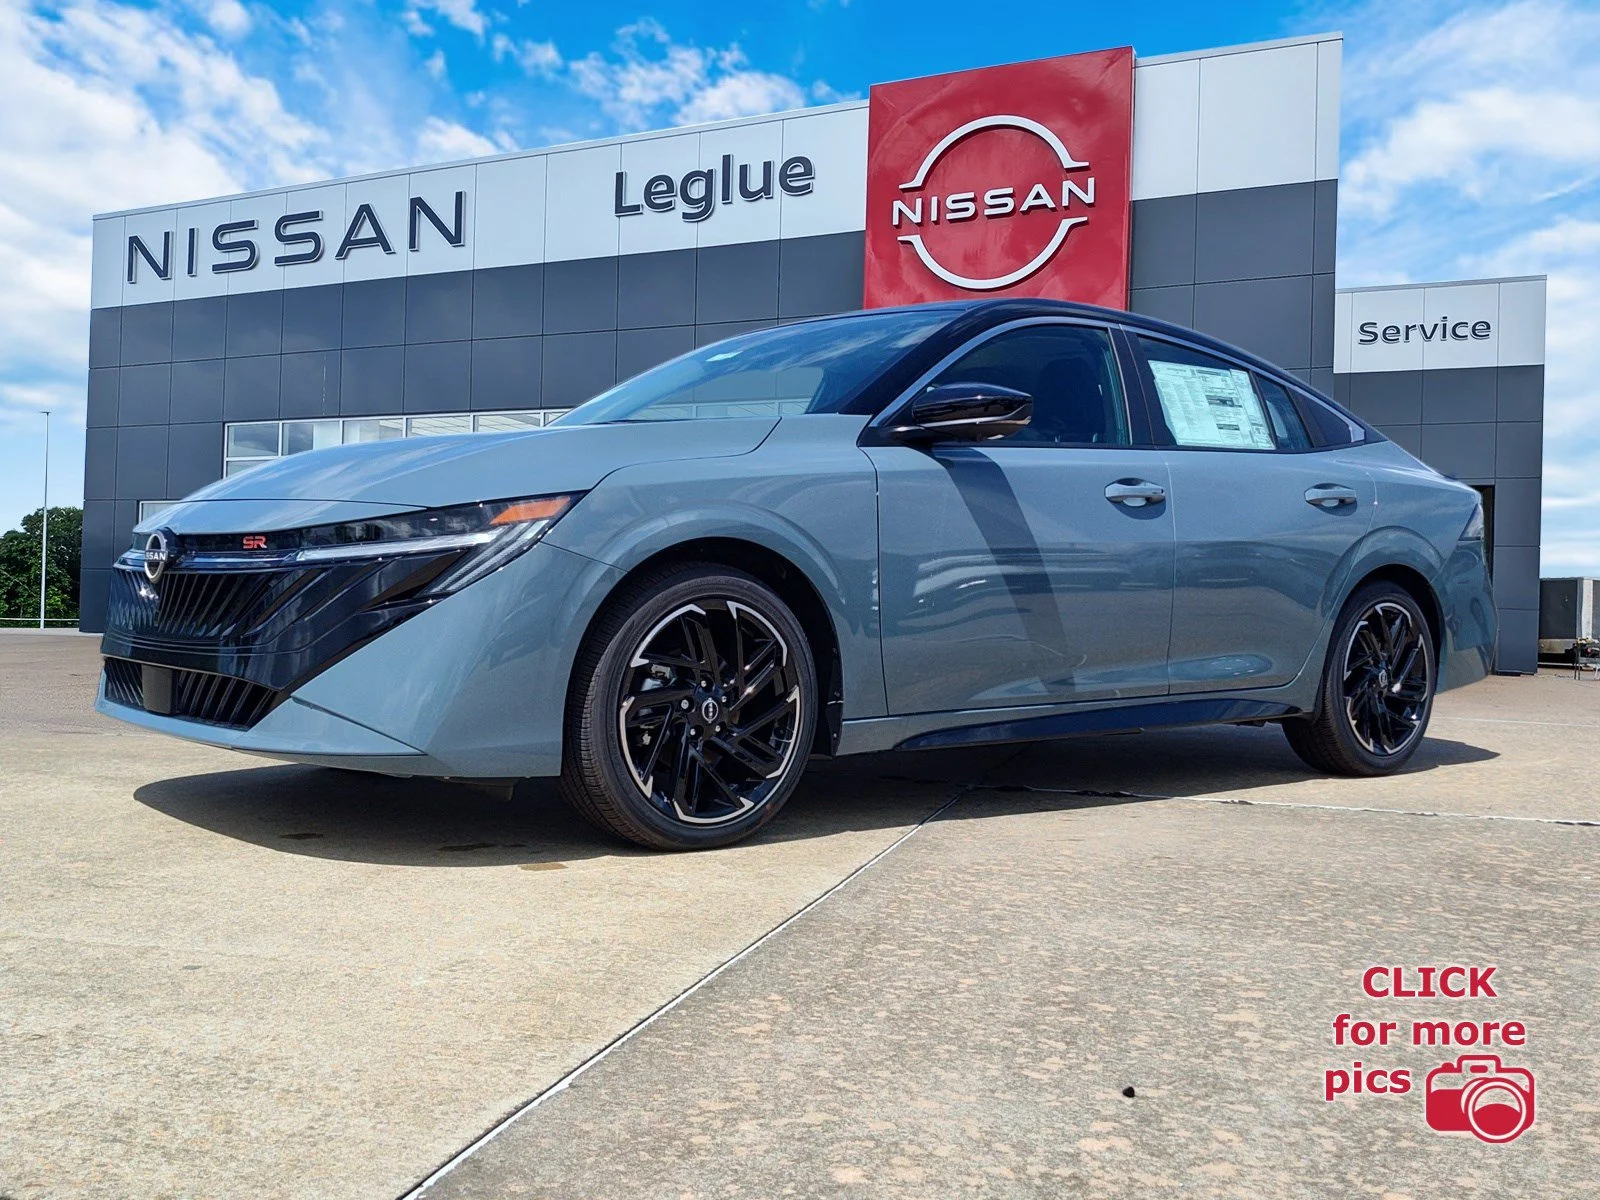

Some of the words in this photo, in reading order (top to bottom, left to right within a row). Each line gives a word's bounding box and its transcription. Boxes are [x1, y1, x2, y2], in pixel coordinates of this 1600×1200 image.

[615, 154, 814, 222] Leglue
[892, 177, 1095, 226] NISSAN
[127, 191, 465, 283] NISSAN
[1358, 316, 1491, 345] Service
[243, 535, 267, 549] SR
